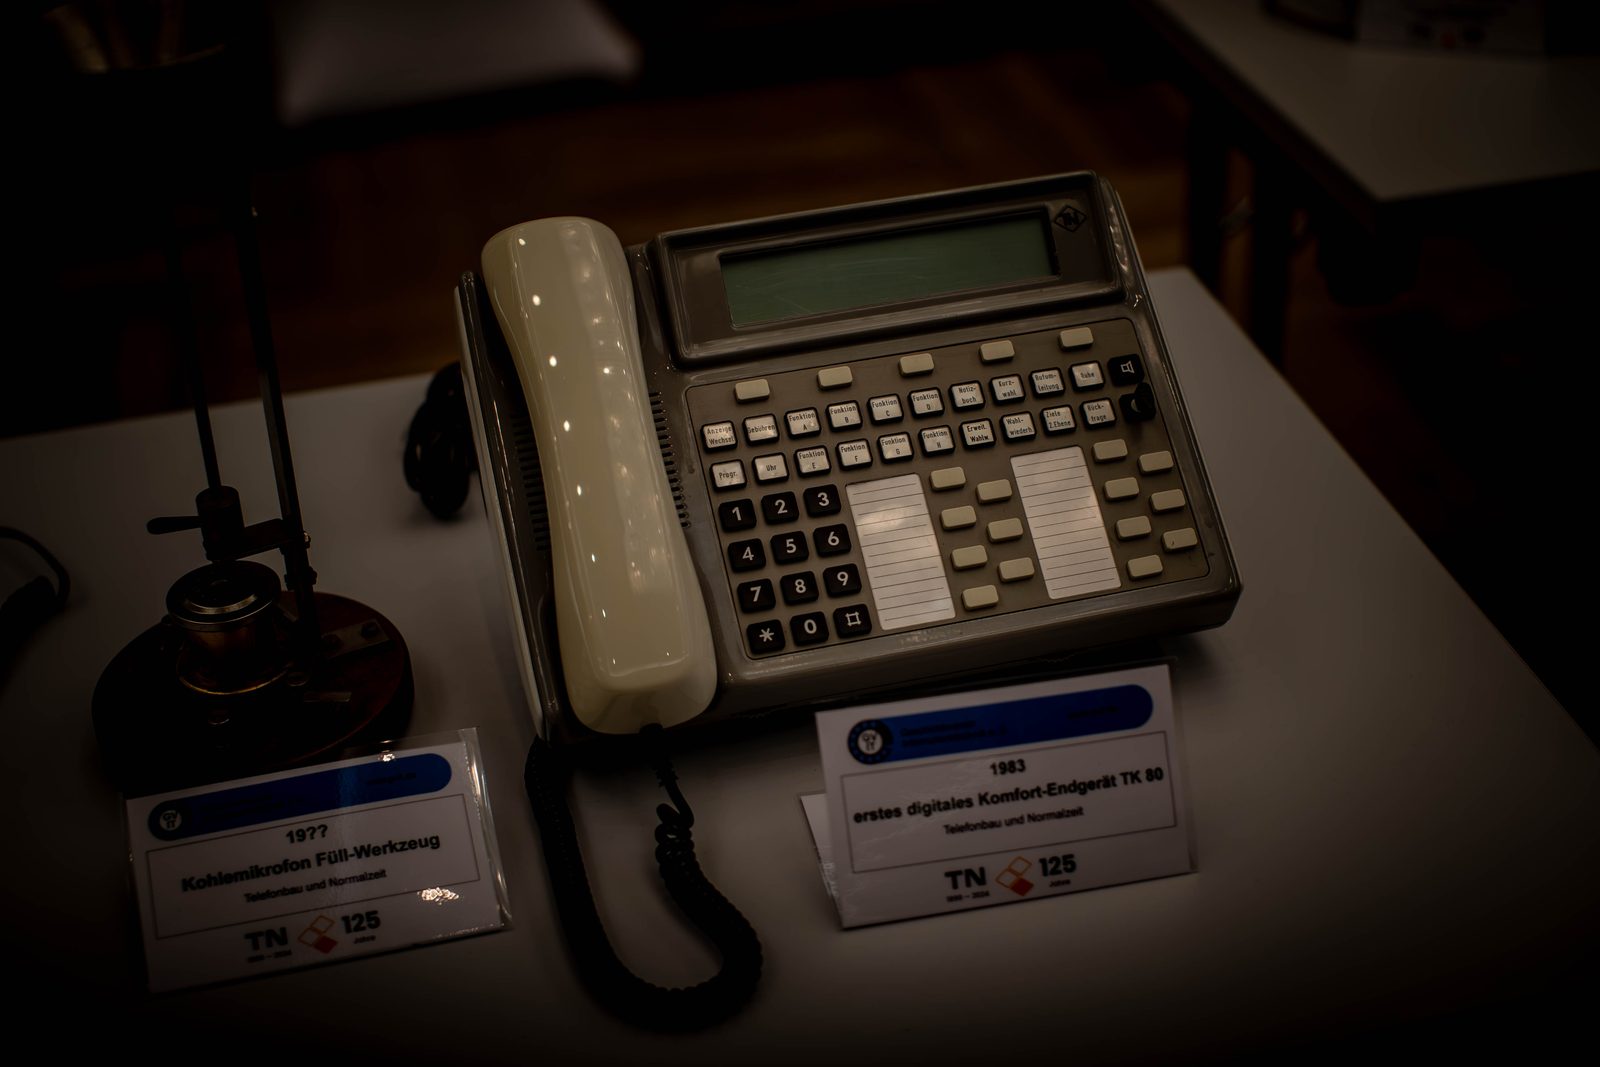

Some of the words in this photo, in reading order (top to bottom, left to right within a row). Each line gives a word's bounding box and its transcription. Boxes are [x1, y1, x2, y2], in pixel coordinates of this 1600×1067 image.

[998, 380, 1015, 388] Kurz-
[1038, 383, 1060, 392] leitung
[958, 386, 977, 394] Notiz-
[1002, 389, 1017, 397] wahl
[912, 392, 939, 402] Funktion
[961, 396, 977, 404] buch
[871, 399, 898, 409] Funktion
[788, 411, 816, 421] Funktion
[829, 405, 857, 416] Funktion
[1046, 410, 1062, 418] Ziele
[844, 416, 849, 424] B
[1006, 417, 1024, 425] Wahl-
[1090, 413, 1107, 423] frage
[706, 425, 733, 436] Anzeige
[802, 423, 808, 431] A
[922, 430, 949, 440] Funktion
[708, 436, 735, 446] Wechsel
[880, 436, 907, 447] Funktion
[840, 443, 866, 453] Funktion
[798, 450, 825, 460] Funktion
[854, 455, 859, 463] F
[765, 464, 778, 472] Uhr
[817, 491, 830, 507] 3
[774, 499, 788, 515] 2
[731, 506, 742, 522] 1
[827, 530, 840, 547] 6
[785, 538, 797, 554] 5
[742, 546, 755, 562] 4
[836, 571, 849, 587] 9
[793, 579, 807, 594] 8
[749, 585, 762, 603] 7
[803, 618, 818, 634] 0
[990, 759, 1026, 776] 1983
[853, 806, 902, 824] erstes
[907, 797, 974, 818] digitales
[978, 774, 1117, 806] Komfort-Endgerät
[1120, 770, 1142, 786] TK
[1145, 767, 1164, 782] 80
[943, 819, 1002, 835] Telefonbau
[1004, 814, 1025, 827] und
[1027, 806, 1084, 824] Normalzeit
[285, 824, 329, 844] 19??
[181, 857, 312, 892] Kohlemikrofon
[315, 834, 441, 868] Füll-Werkzeug
[1038, 854, 1077, 877] 125
[944, 866, 987, 891] TN
[243, 884, 304, 903] Telefonbau
[305, 877, 327, 892] und
[328, 869, 387, 889] Normalzeit
[340, 910, 381, 934] 125
[244, 926, 289, 952] TN
